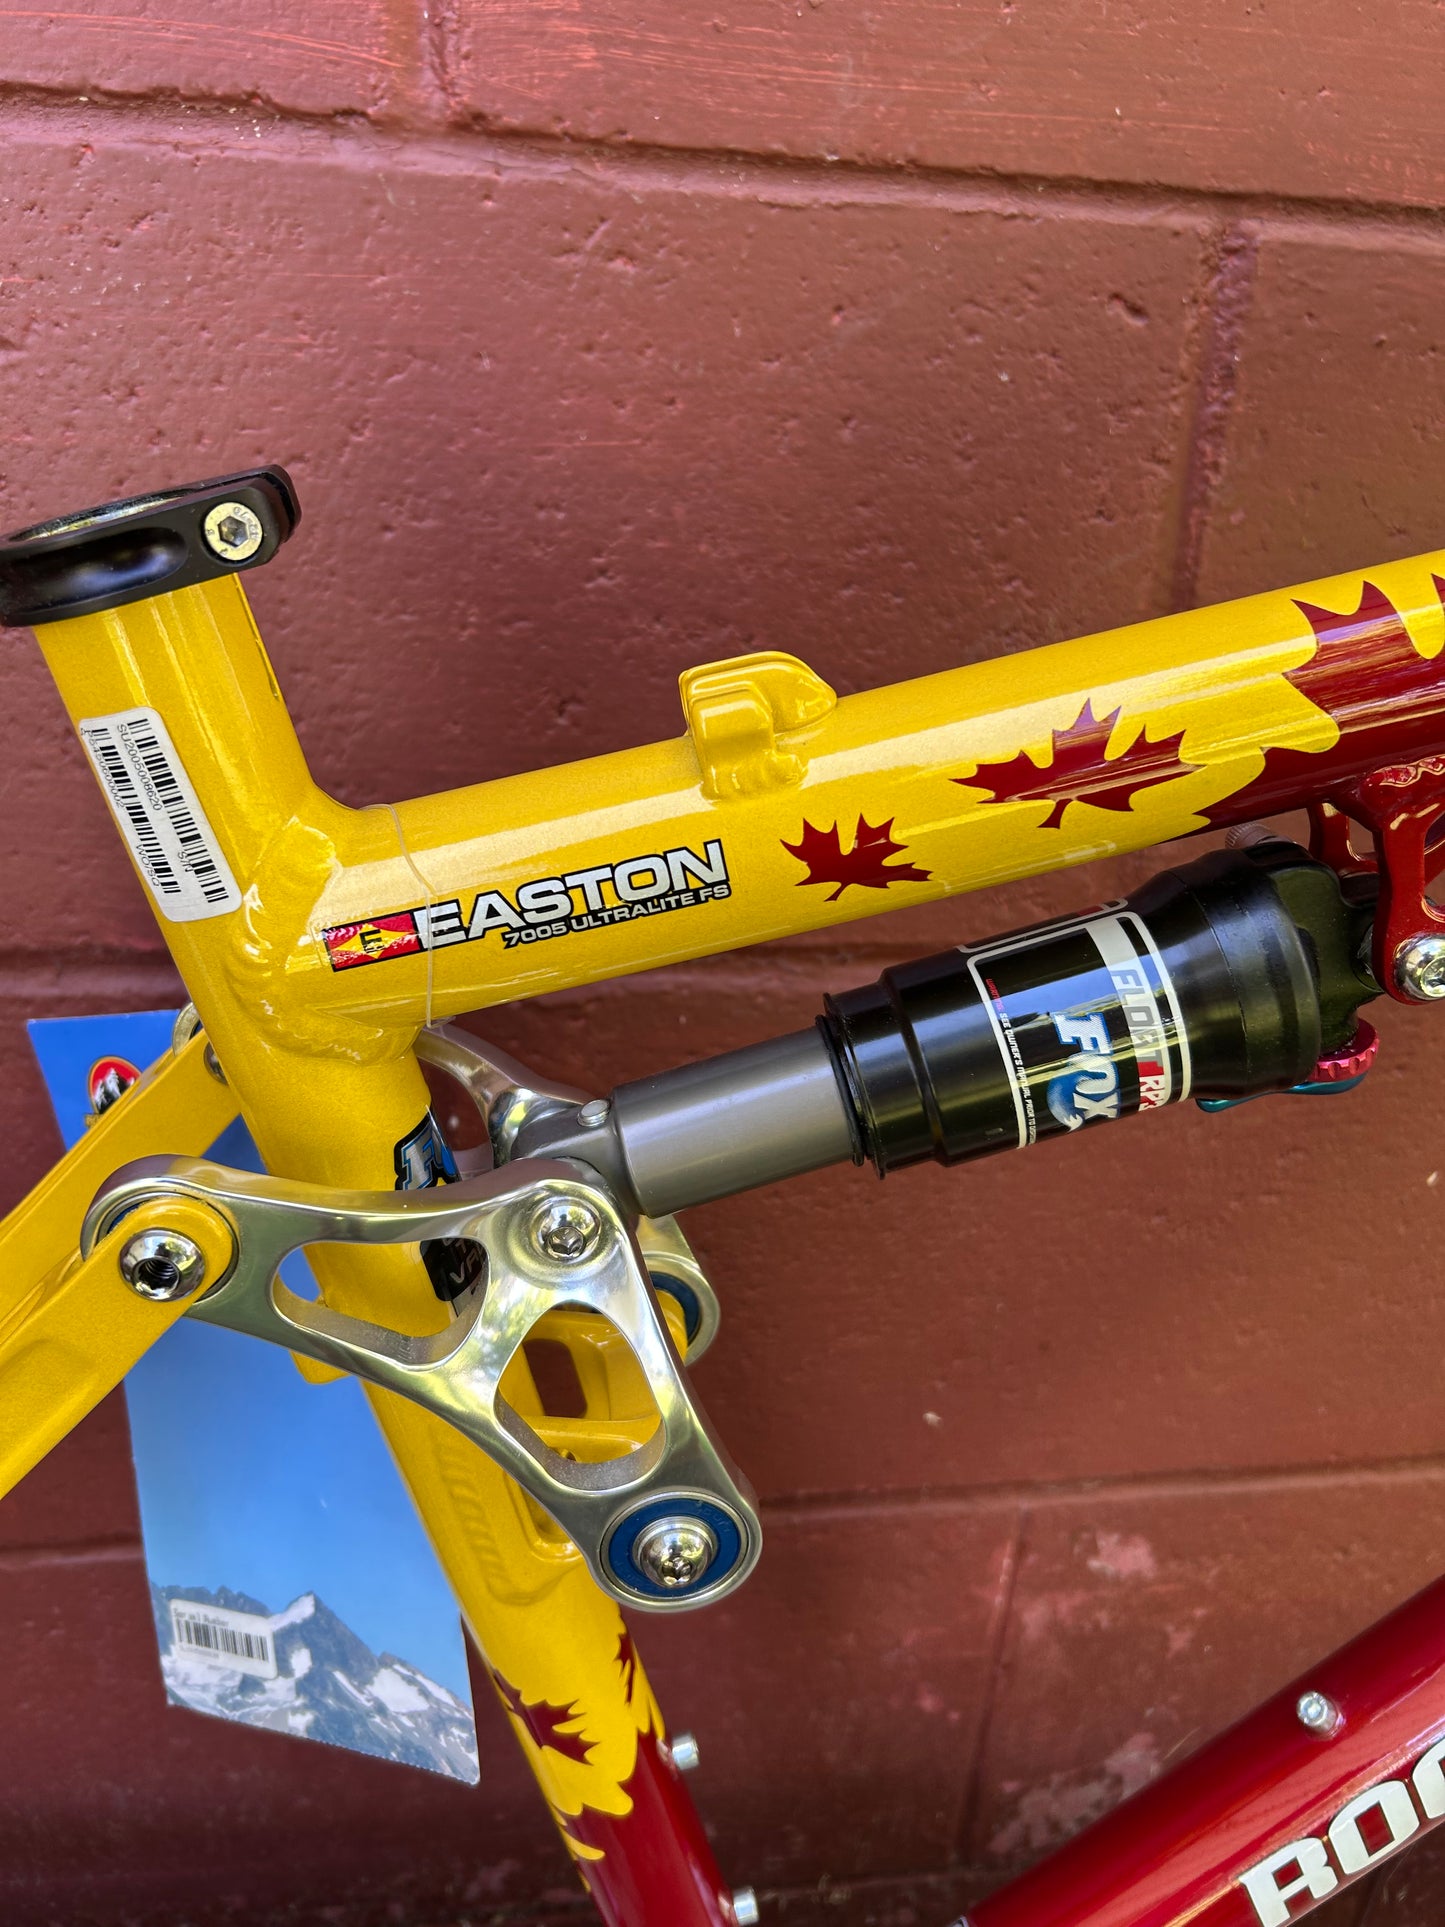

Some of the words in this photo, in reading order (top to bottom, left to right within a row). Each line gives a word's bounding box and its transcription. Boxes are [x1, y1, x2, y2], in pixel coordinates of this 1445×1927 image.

[117, 724, 162, 811] SU2005008620
[178, 851, 194, 873] S/N
[413, 840, 729, 950] EASTON
[502, 921, 569, 947] 7005
[570, 892, 697, 932] ULTRALITE
[700, 883, 731, 904] FS
[1049, 1010, 1122, 1121] FOX
[1110, 968, 1165, 1068] FLOAT
